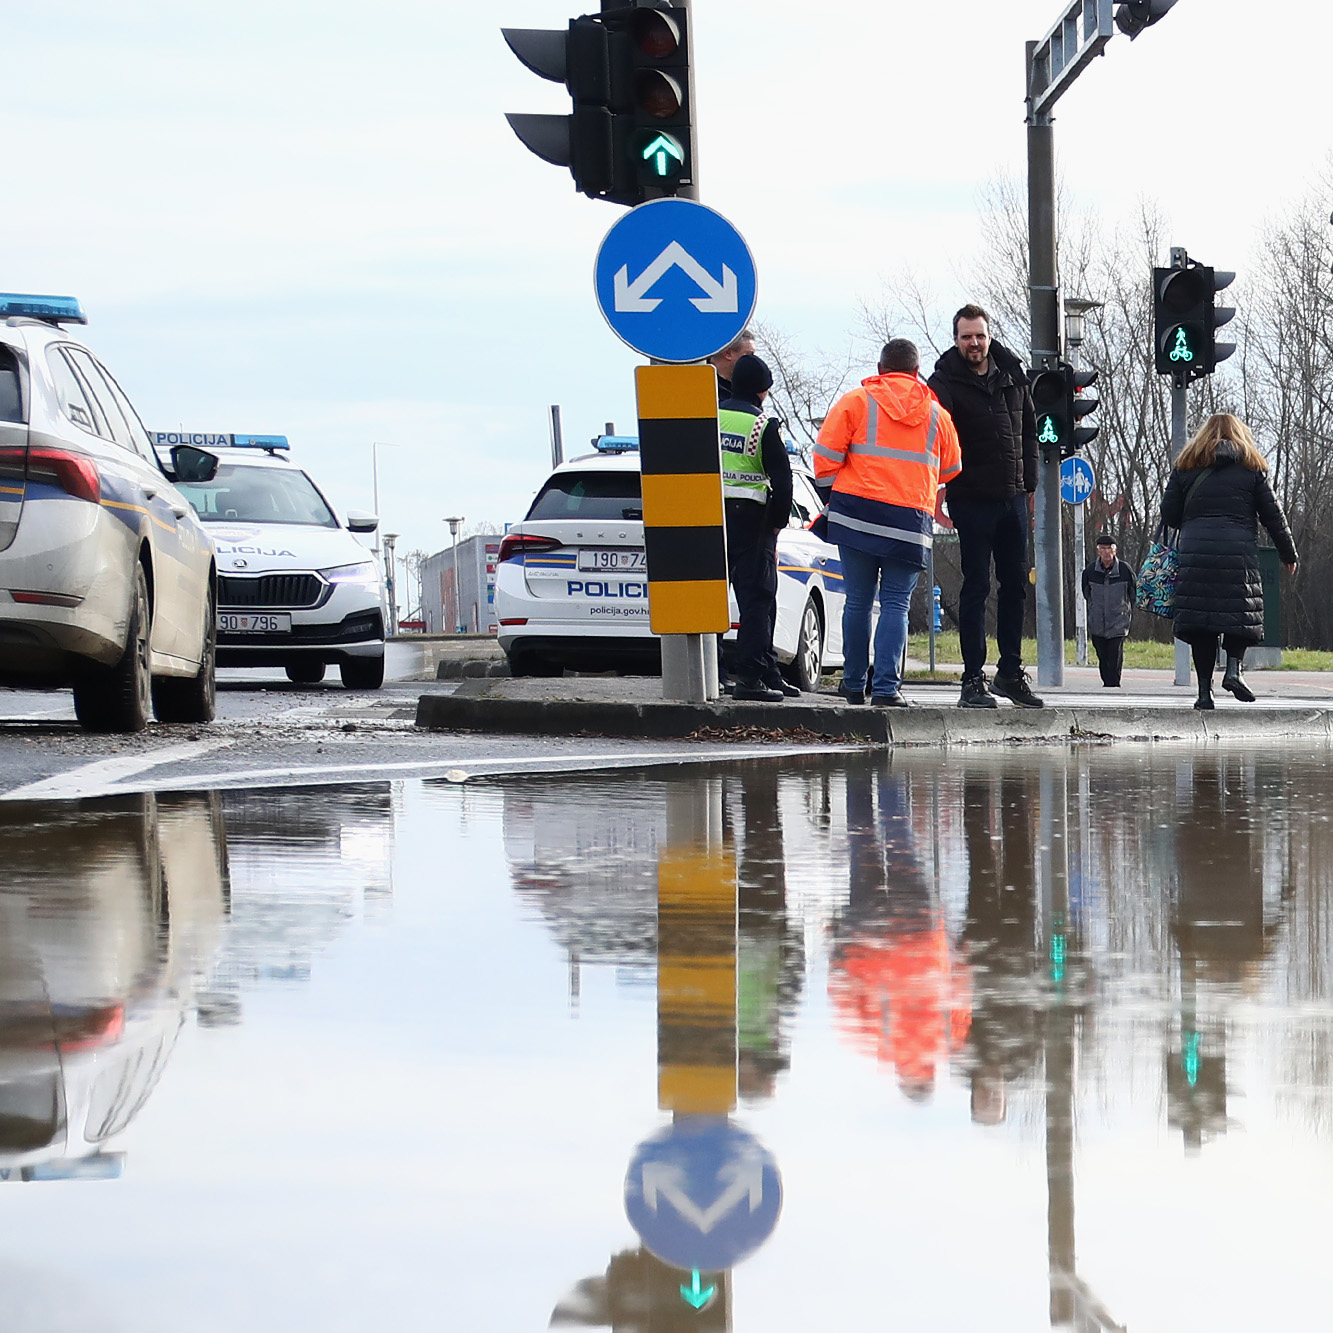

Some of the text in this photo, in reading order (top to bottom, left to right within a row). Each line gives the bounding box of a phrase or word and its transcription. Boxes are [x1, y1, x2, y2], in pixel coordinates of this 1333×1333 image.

[157, 432, 228, 445] POLICIJA
[722, 437, 743, 449] CIJA
[216, 546, 297, 557] LICIJA
[594, 552, 618, 567] 190
[567, 581, 648, 598] POLICI
[220, 615, 278, 630] 90 796
